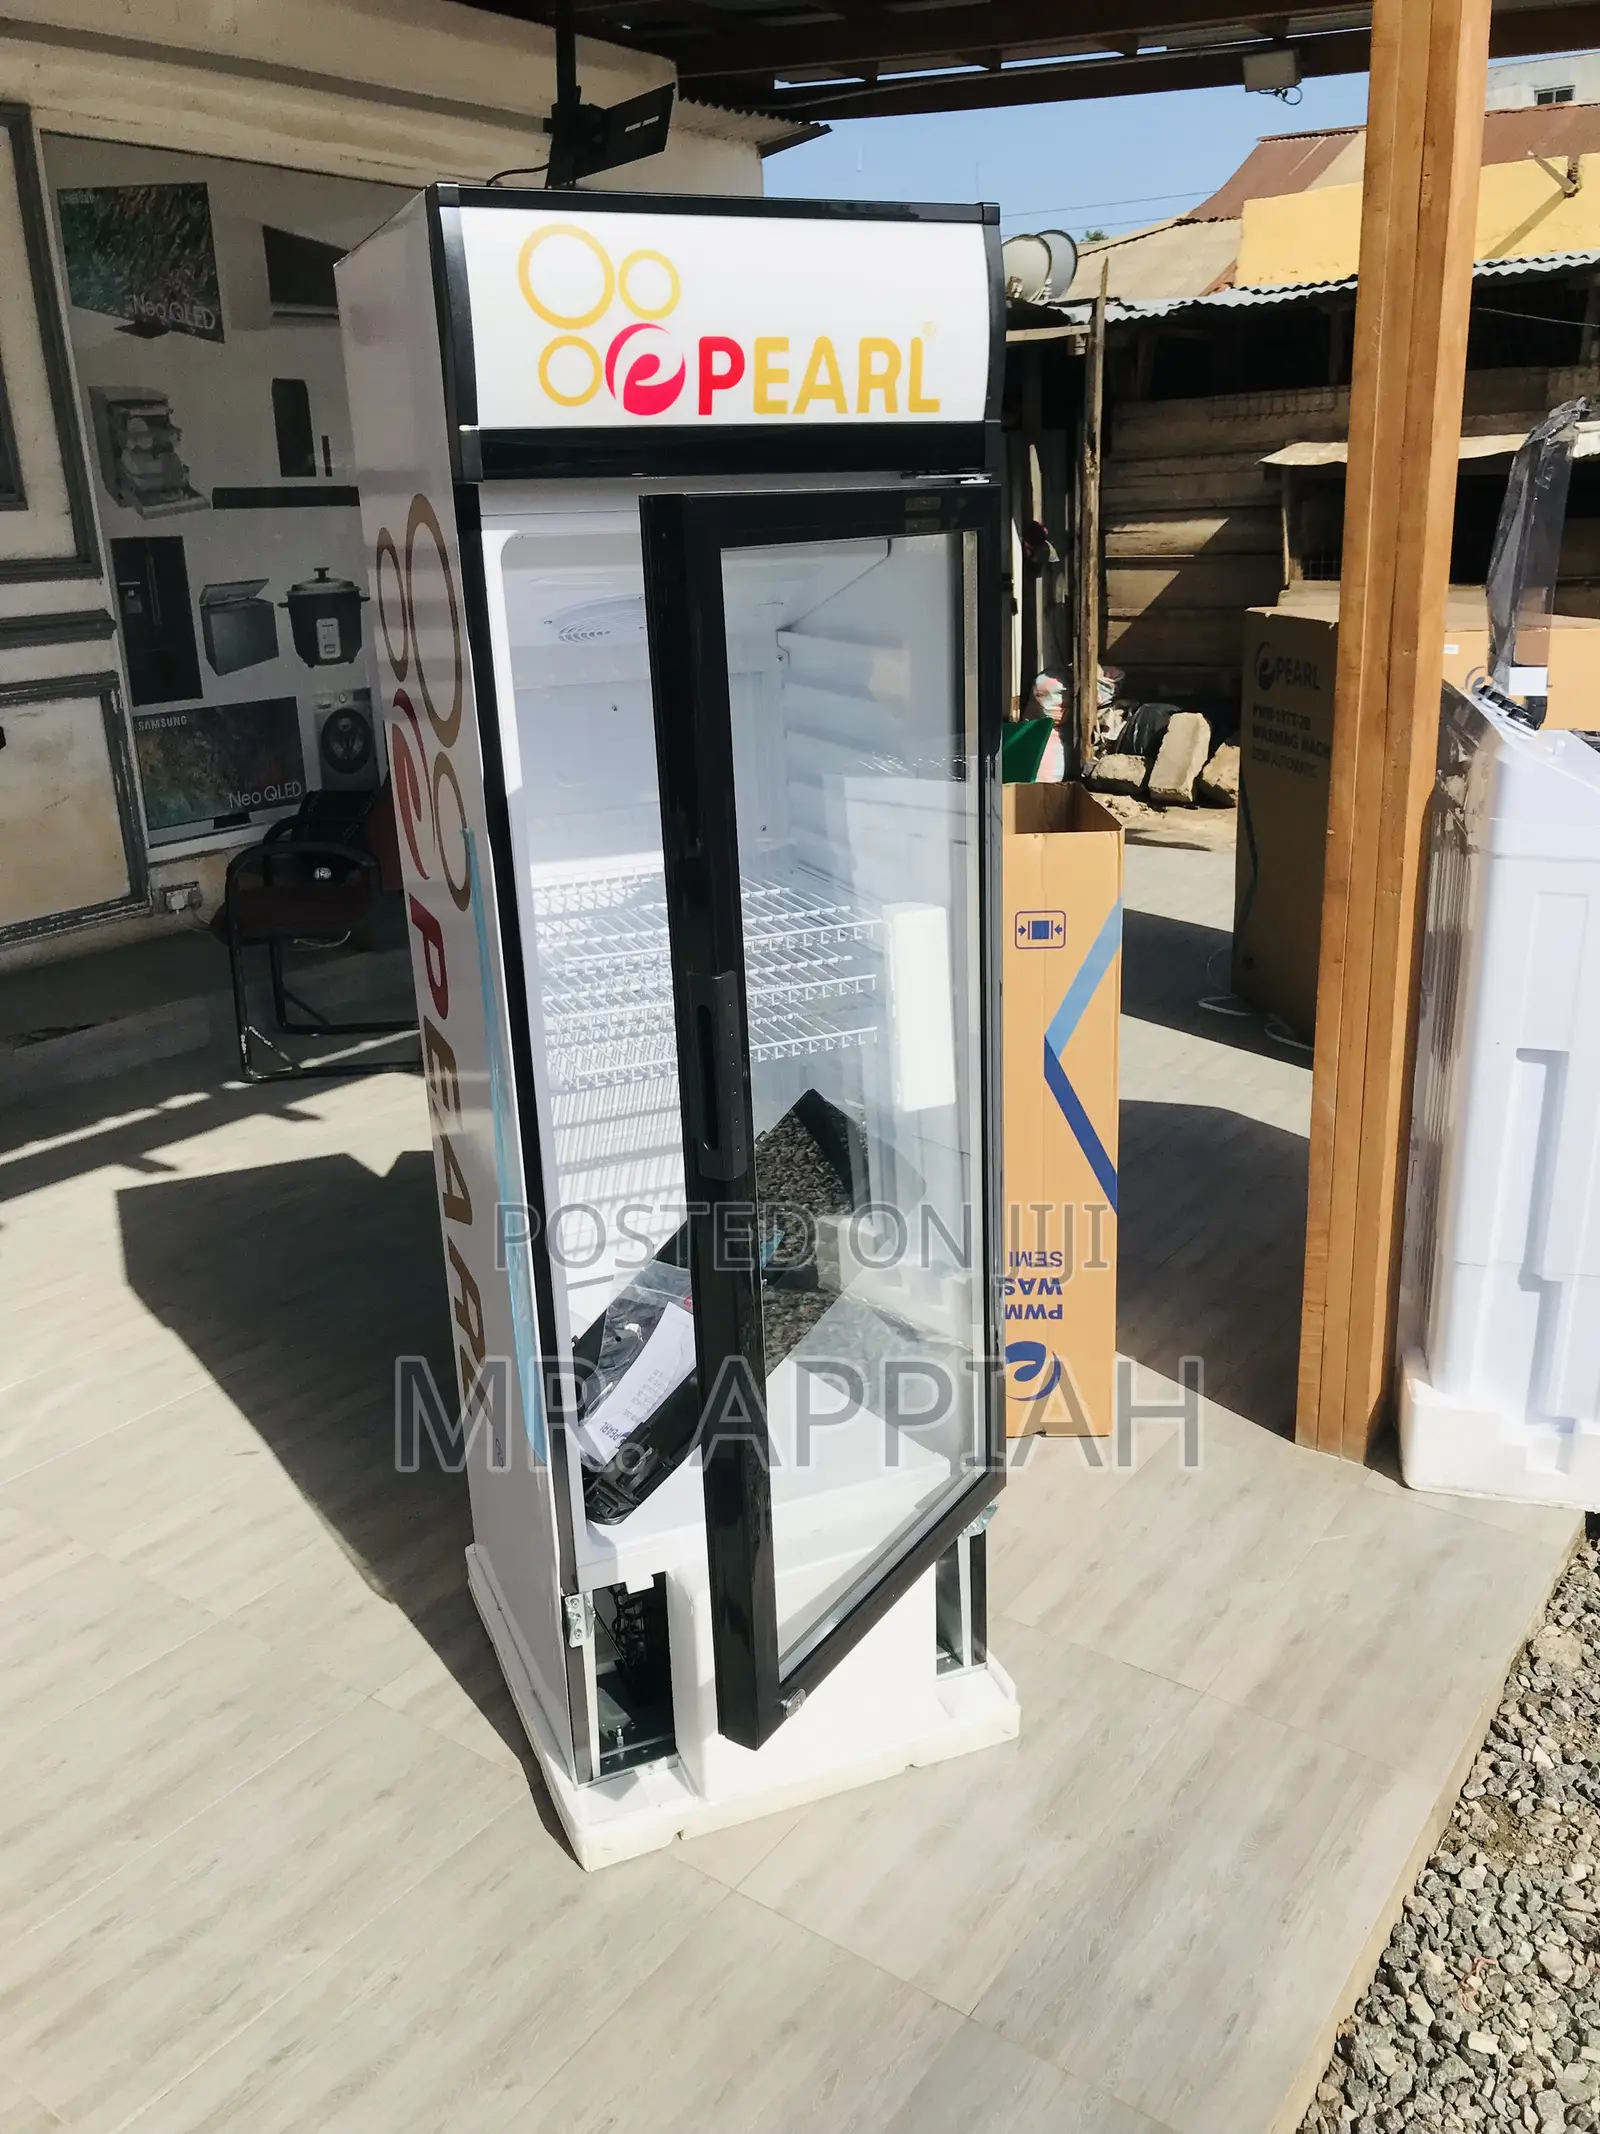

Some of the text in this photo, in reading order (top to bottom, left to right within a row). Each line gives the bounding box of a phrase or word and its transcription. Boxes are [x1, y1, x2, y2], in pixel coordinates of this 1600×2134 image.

[132, 294, 216, 330] Neo QLED
[698, 335, 941, 416] PEARL
[1273, 656, 1320, 690] PEARL
[138, 715, 188, 731] SAMSUNG
[228, 781, 302, 809] Neo QLED
[1009, 1251, 1064, 1268] SEMI
[1004, 1303, 1063, 1320] PWM
